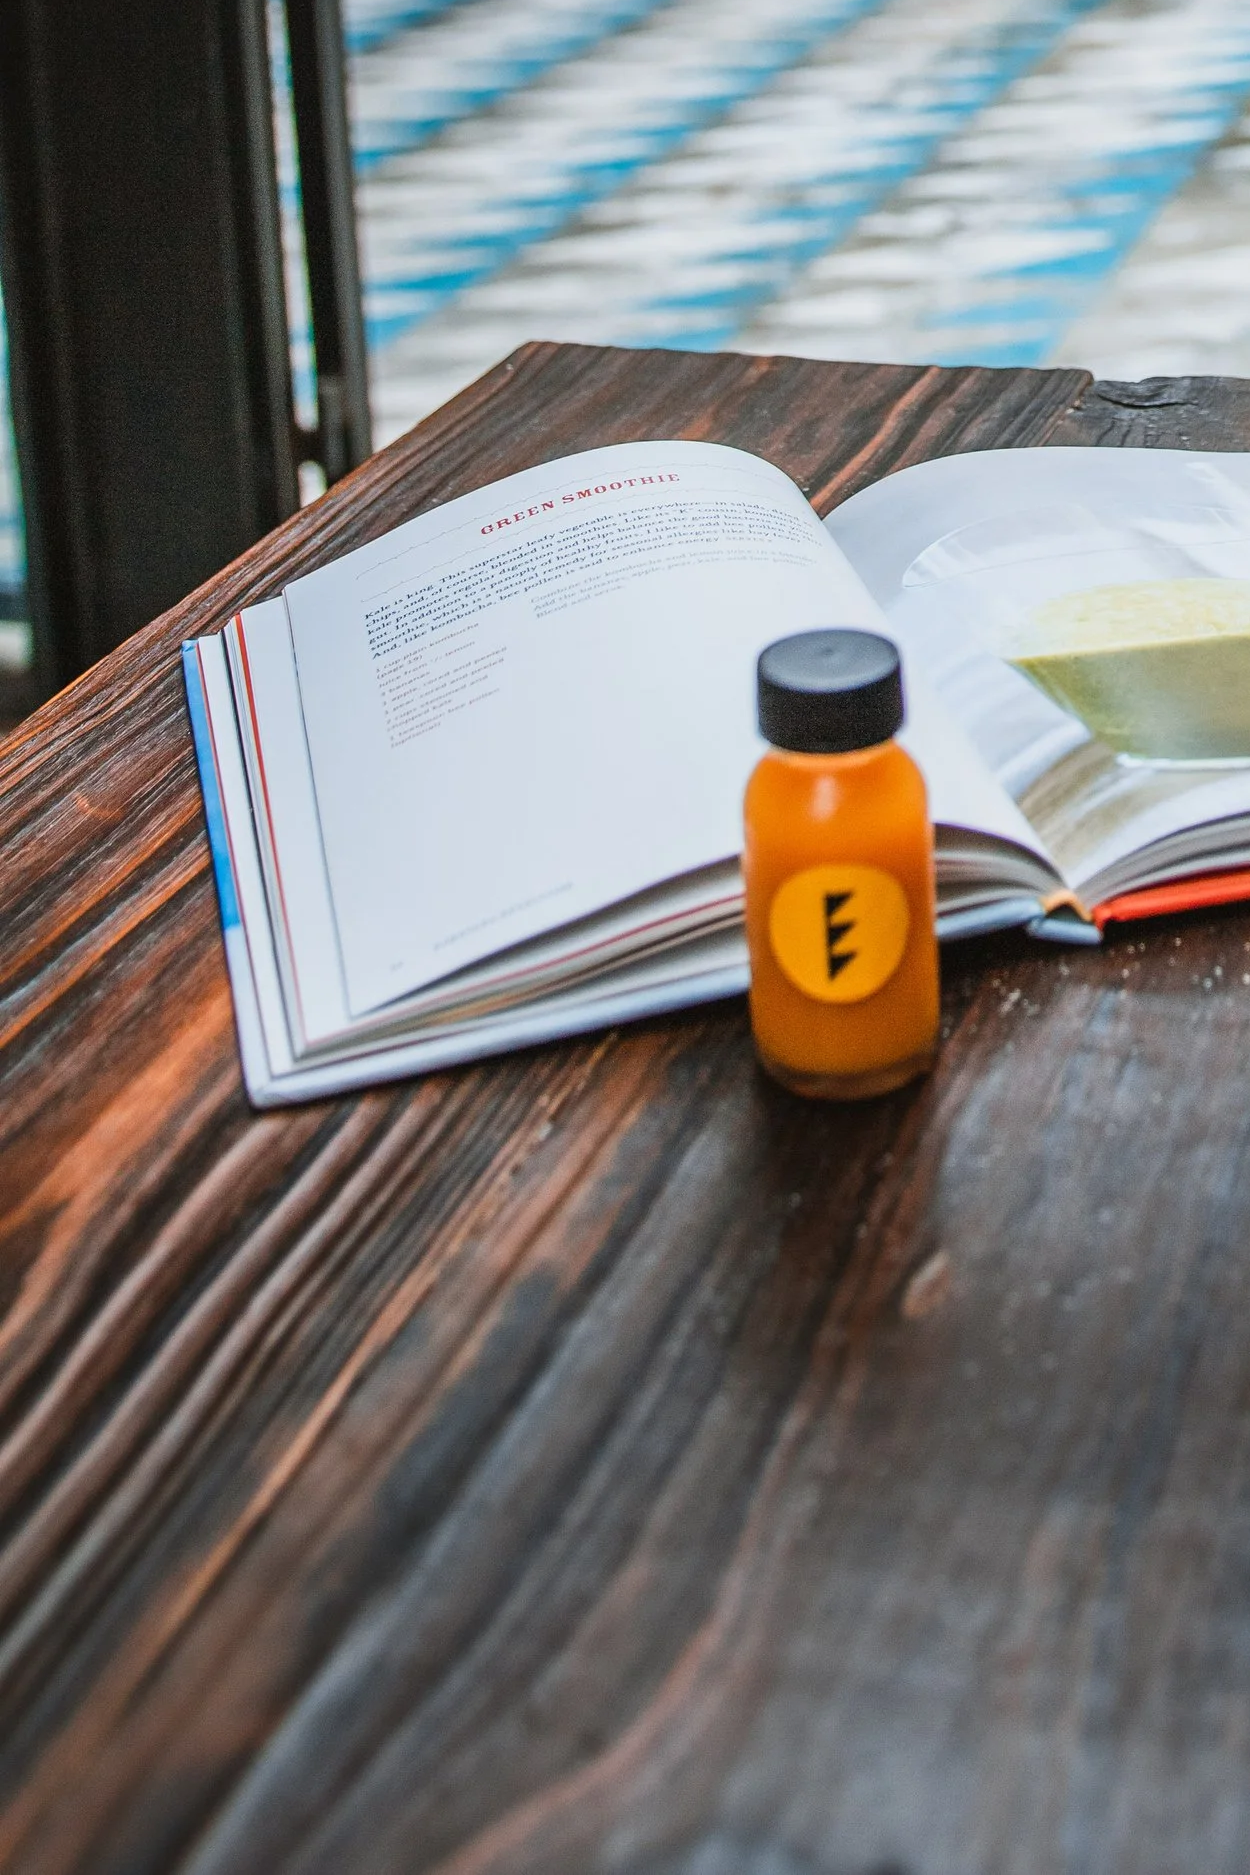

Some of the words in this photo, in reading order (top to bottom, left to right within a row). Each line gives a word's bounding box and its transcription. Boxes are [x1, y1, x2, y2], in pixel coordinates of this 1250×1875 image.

[480, 500, 554, 535] GREEN
[562, 473, 680, 504] SMOOTHIE
[365, 605, 390, 619] Kale
